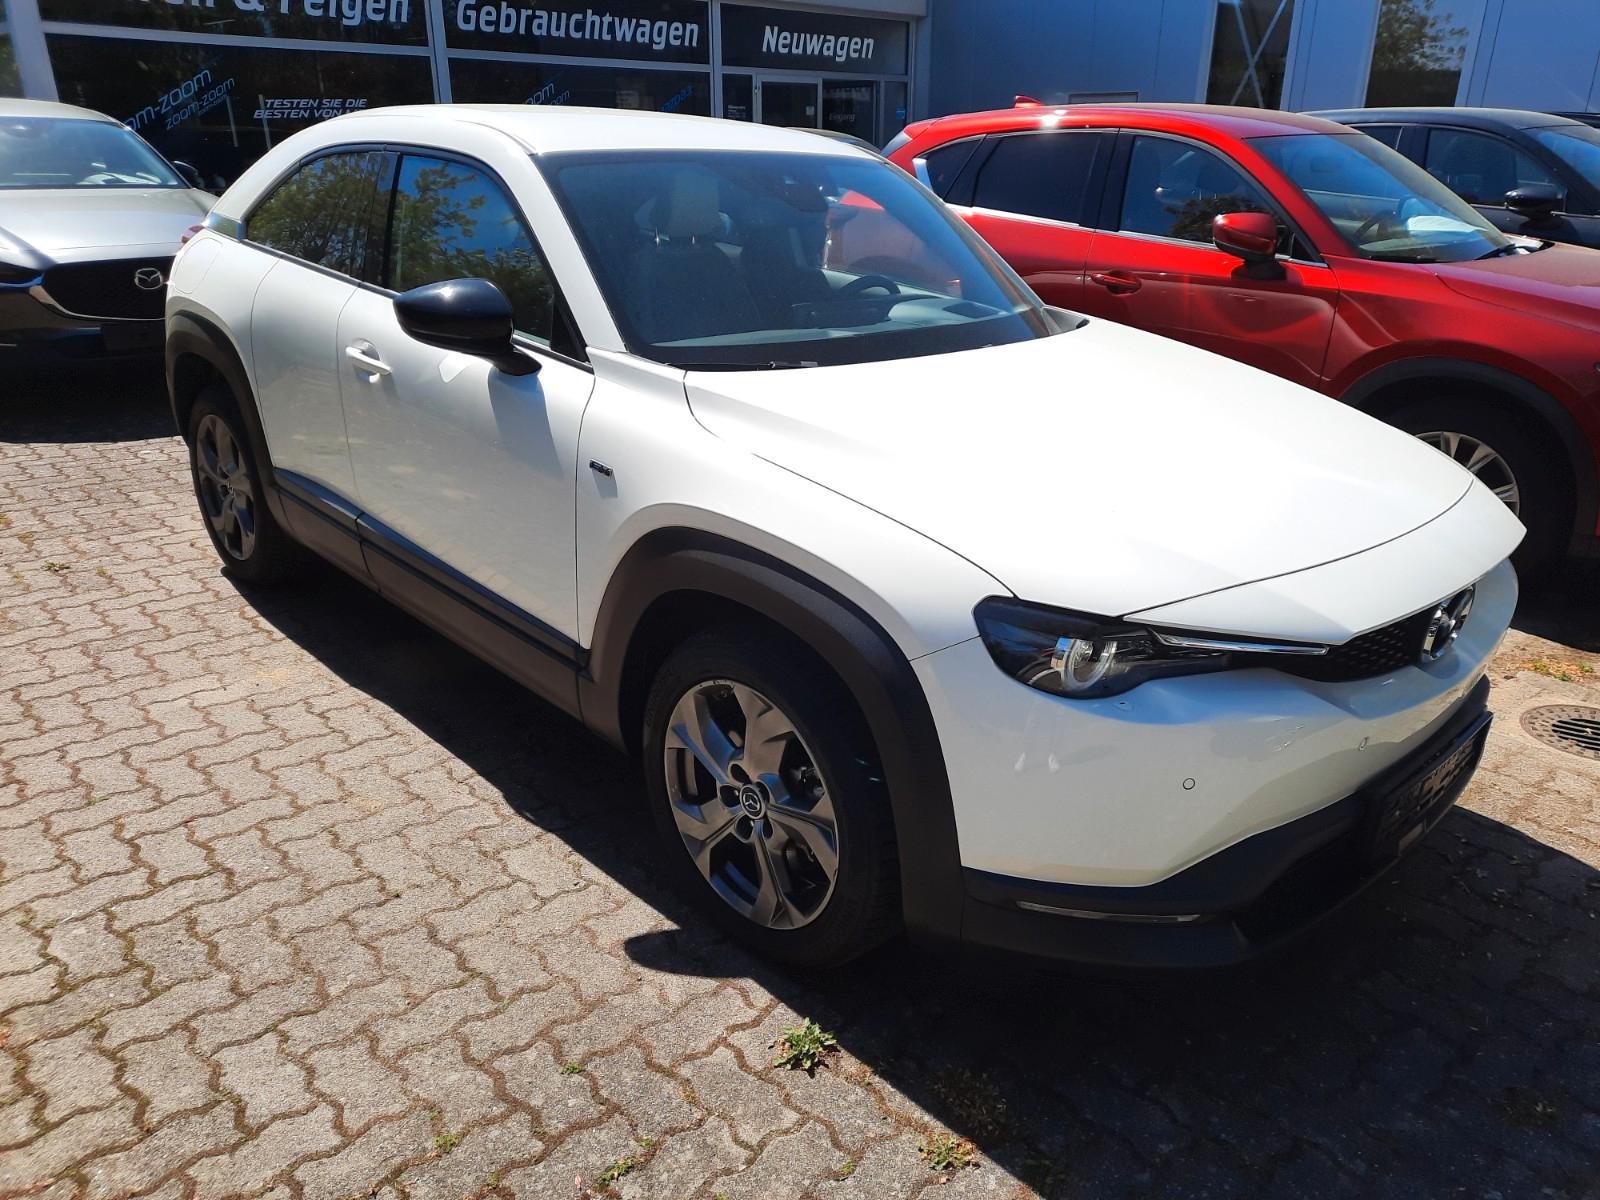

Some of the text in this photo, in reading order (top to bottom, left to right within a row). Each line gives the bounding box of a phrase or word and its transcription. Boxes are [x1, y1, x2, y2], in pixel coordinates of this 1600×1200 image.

[456, 0, 699, 50] Gebrauchtwagen
[762, 25, 875, 62] Neuwagen
[165, 78, 236, 131] zoom-zoom
[253, 109, 310, 119] BESTEN
[313, 109, 342, 118] VON
[264, 98, 368, 108] TESTEN SIE DIE
